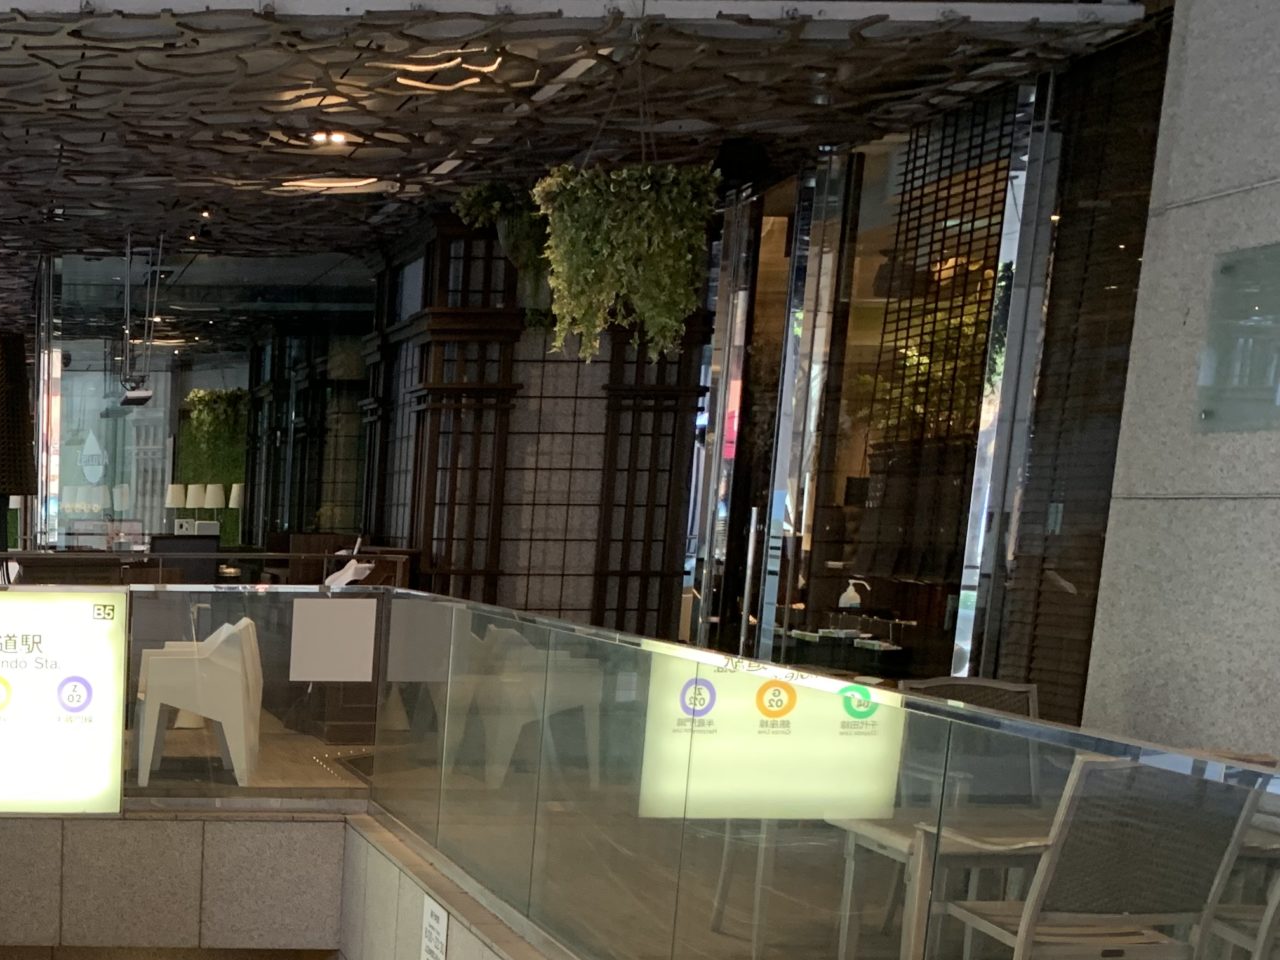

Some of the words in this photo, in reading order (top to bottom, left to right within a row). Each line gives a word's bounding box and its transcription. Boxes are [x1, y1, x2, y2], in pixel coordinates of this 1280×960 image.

[94, 605, 115, 619] B5
[71, 685, 78, 693] Z
[67, 694, 82, 703] 02
